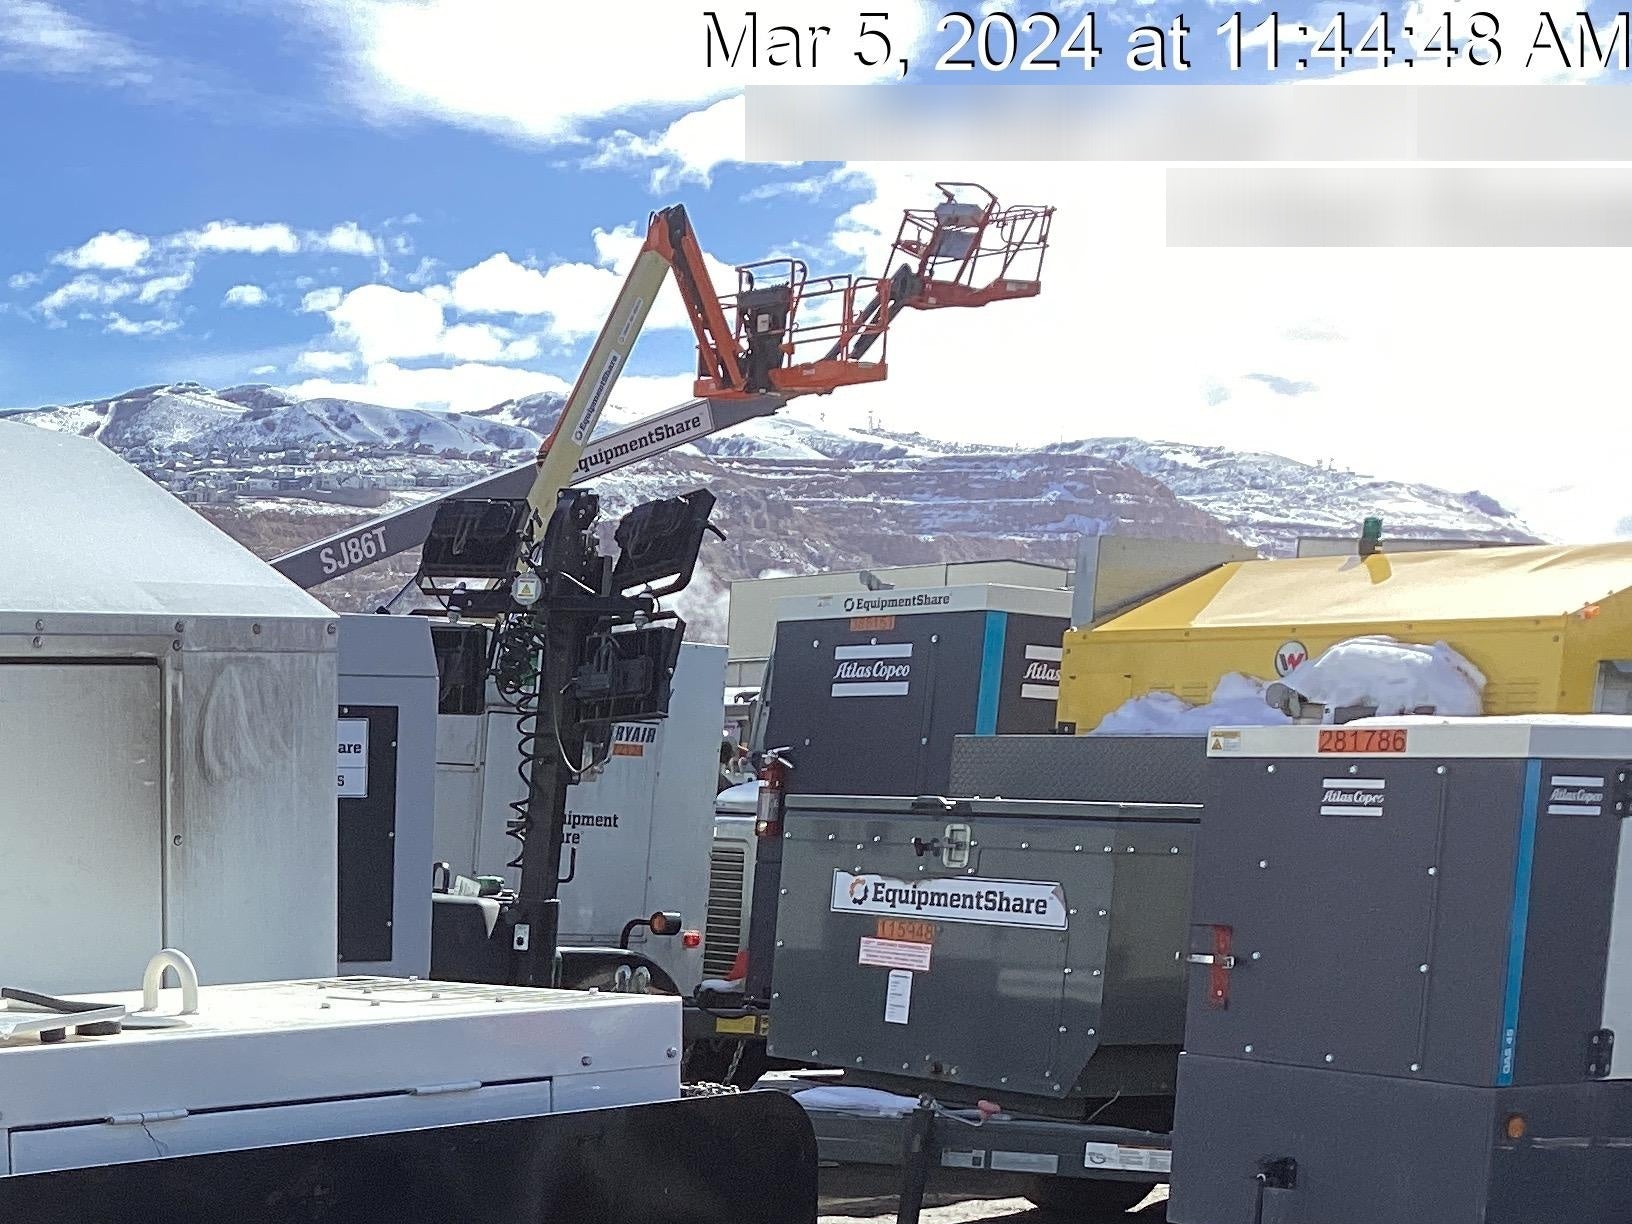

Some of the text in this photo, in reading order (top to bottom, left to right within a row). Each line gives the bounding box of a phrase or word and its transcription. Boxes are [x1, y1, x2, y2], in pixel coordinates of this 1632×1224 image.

[572, 416, 702, 474] quipmentShare
[320, 526, 386, 574] SJ86T
[856, 594, 950, 611] EquipmentShare
[833, 661, 911, 681] Atlas Copco
[1023, 662, 1061, 681] Atlas
[1321, 729, 1405, 752] 281786
[1322, 789, 1385, 806] Atlas Copco
[1549, 788, 1604, 805] Atlas Copco
[871, 882, 1048, 915] EquipmentShare
